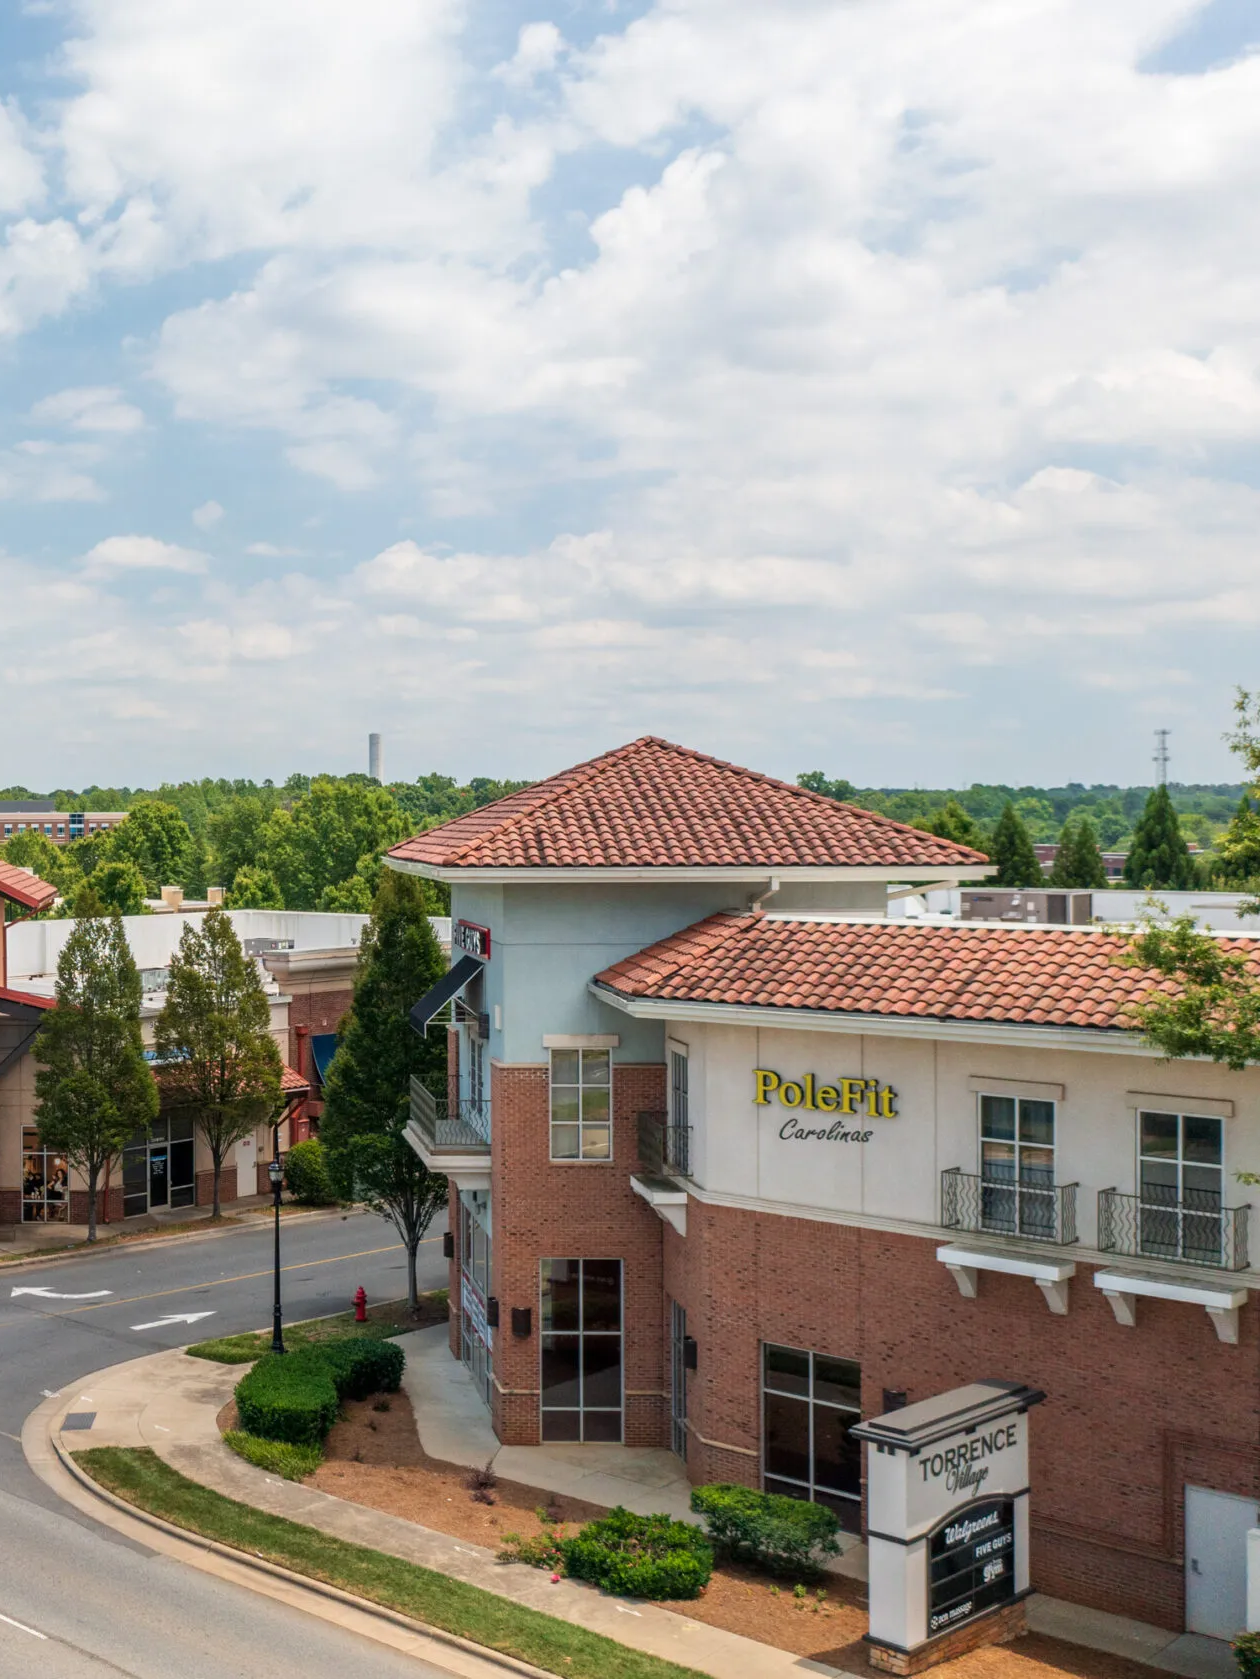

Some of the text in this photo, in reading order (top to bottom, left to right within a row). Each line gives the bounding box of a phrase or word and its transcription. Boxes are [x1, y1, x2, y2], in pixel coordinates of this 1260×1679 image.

[752, 1069, 898, 1118] PoleFit
[778, 1118, 874, 1143] Carolinas
[919, 1423, 1017, 1482] TORRENCE
[945, 1464, 989, 1497] Village
[944, 1510, 999, 1545] Walgreens
[975, 1532, 1012, 1558] FIVE GUYS
